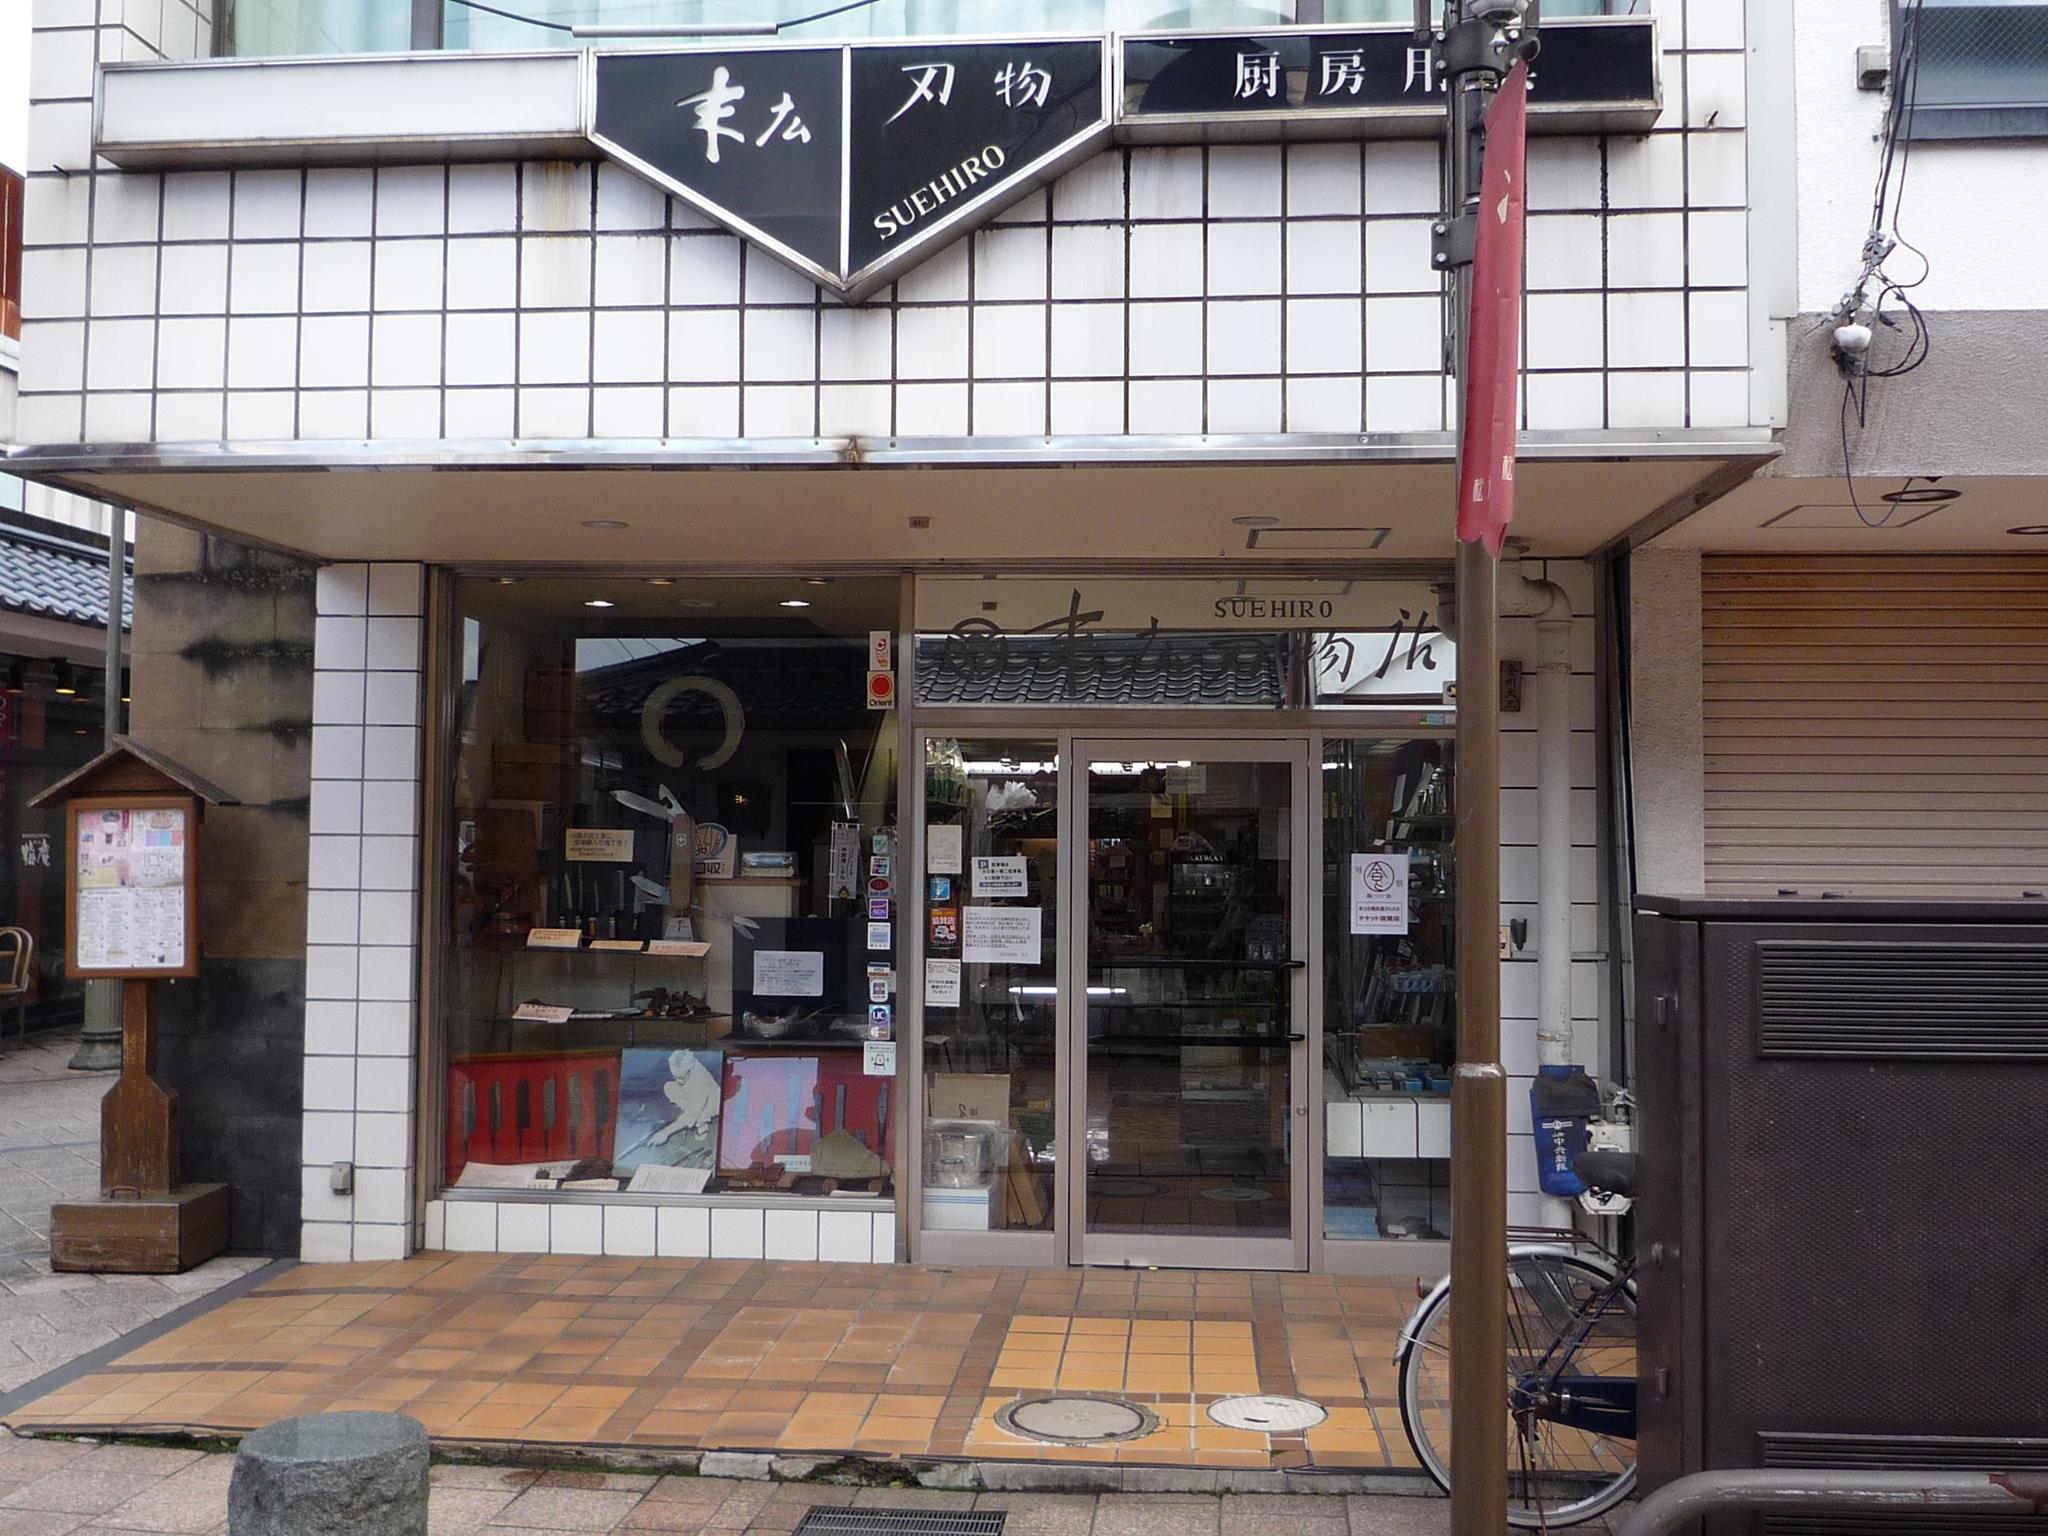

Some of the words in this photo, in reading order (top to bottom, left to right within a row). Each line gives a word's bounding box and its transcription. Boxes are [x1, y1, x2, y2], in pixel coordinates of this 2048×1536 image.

[884, 61, 1052, 124] 刃物
[1233, 46, 1537, 99] 厨房用
[676, 66, 812, 163] 末広
[873, 145, 1006, 240] SUEHIRO
[1214, 599, 1334, 619] SUEHIRO
[869, 699, 893, 707] Orient
[872, 1010, 888, 1020] UC
